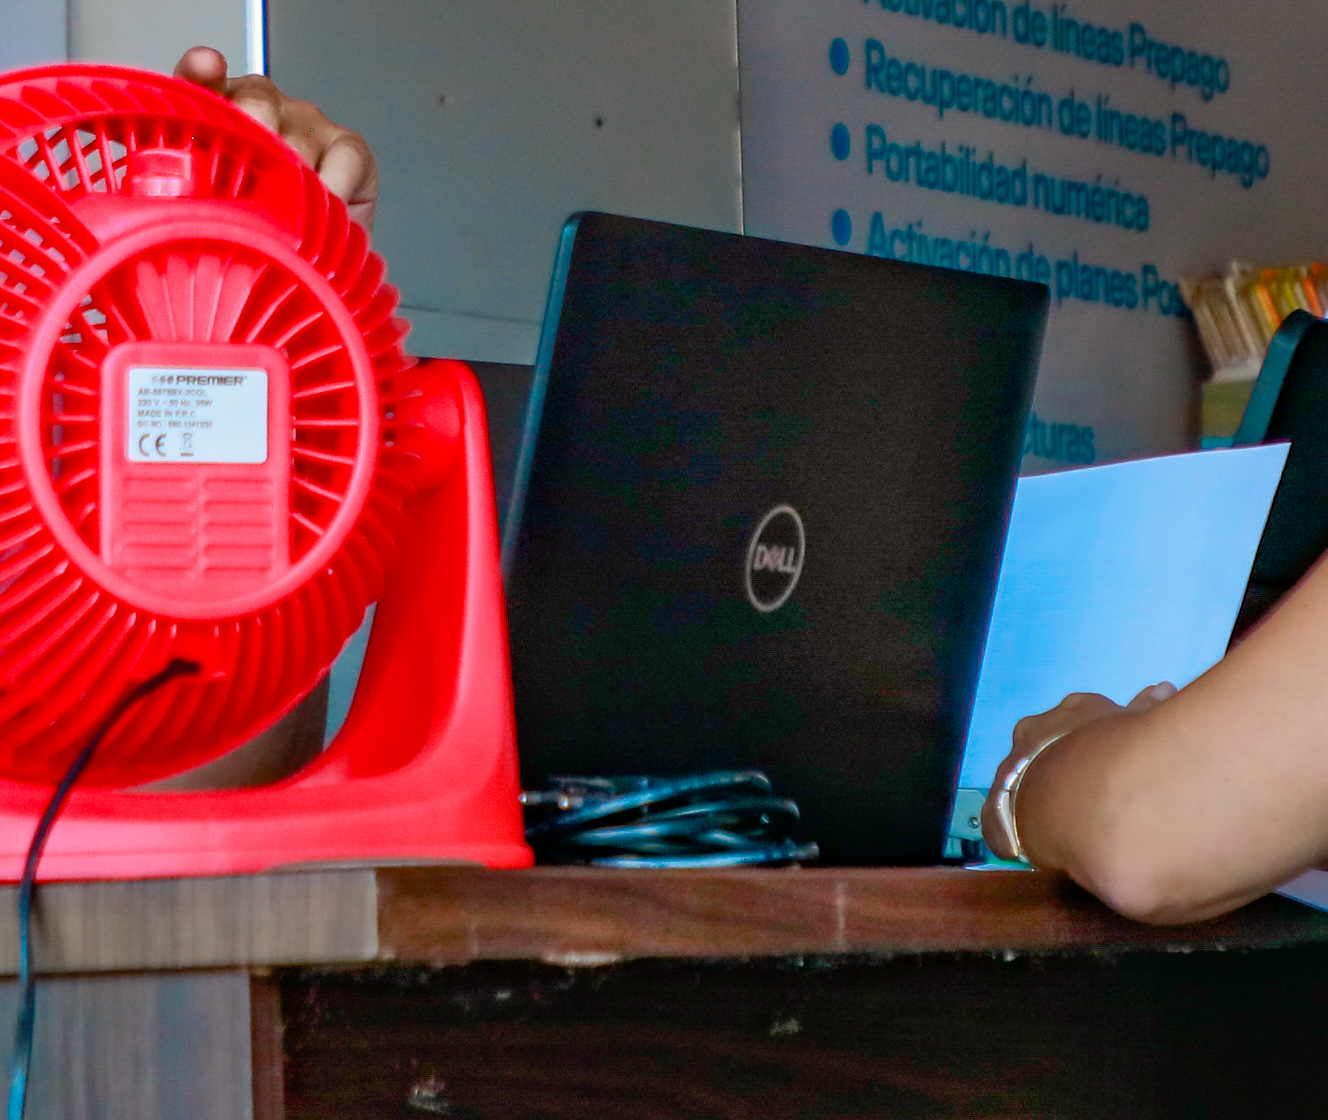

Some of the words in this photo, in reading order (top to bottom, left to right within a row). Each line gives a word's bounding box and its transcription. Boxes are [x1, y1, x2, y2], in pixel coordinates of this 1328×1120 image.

[1051, 2, 1125, 67] líneas
[1128, 23, 1230, 101] Prepago
[865, 38, 1053, 129] Recuperación
[1058, 87, 1093, 139] de
[1096, 93, 1167, 157] líneas
[1170, 112, 1270, 189] Prepago
[865, 123, 1028, 207] Portabilidad
[1033, 174, 1150, 232] numérica
[1055, 251, 1139, 310] planes
[175, 375, 245, 386] PREMIER
[137, 409, 162, 418] MADE
[164, 410, 173, 418] IN
[753, 542, 798, 574] DELL
